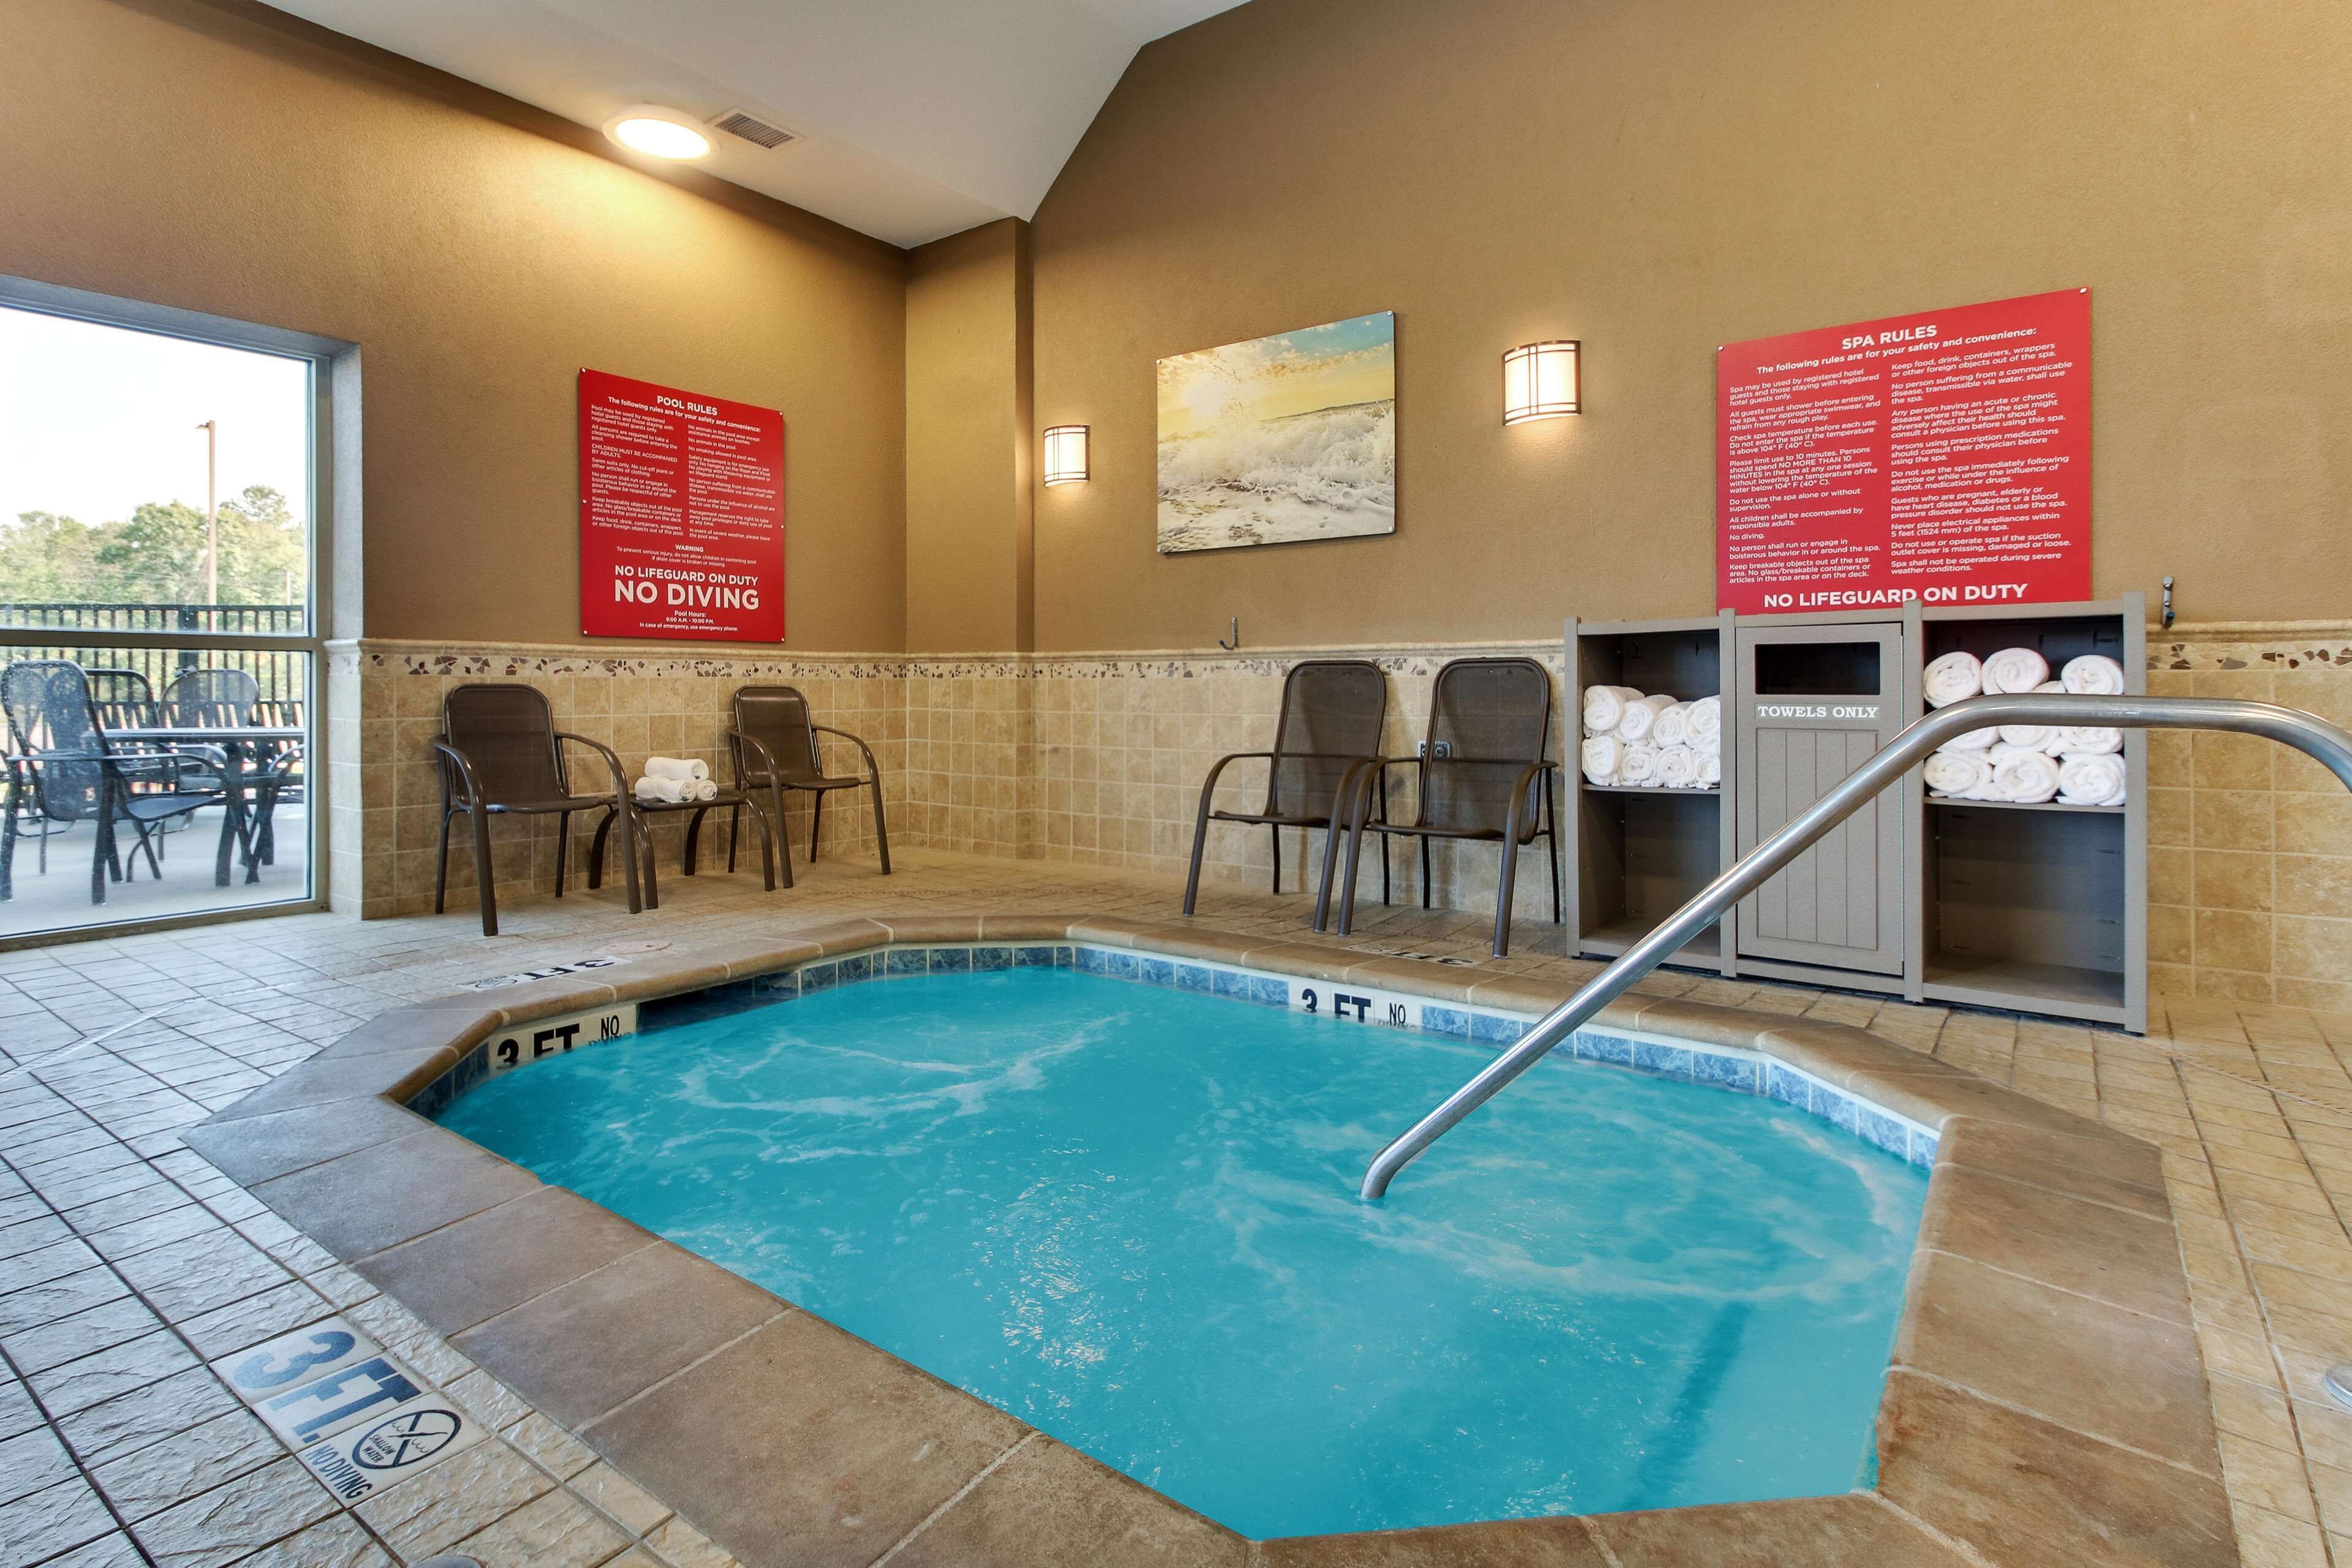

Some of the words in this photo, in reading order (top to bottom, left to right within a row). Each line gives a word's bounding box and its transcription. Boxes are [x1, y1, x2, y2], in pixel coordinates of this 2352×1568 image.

[1842, 334, 1875, 349] SPA
[1880, 325, 1937, 344] RULES
[1775, 360, 1819, 371] following
[1821, 356, 1845, 364] rules
[1882, 347, 1905, 357] your
[1908, 342, 1940, 352] safety
[1942, 337, 1962, 347] and
[1965, 328, 2036, 344] convenience:
[1804, 372, 1842, 382] registered
[621, 399, 648, 410] following
[657, 395, 684, 409] POOL
[687, 402, 717, 415] RULES
[1891, 421, 1929, 431] adversely
[2007, 409, 2036, 418] should
[1950, 434, 2002, 445] prescription
[2004, 428, 2059, 439] medications
[1975, 440, 2016, 450] physician
[1793, 458, 1815, 467] MORE
[1924, 480, 1972, 489] medication
[1800, 508, 1851, 517] accompanied
[1982, 515, 2029, 524] appliances
[615, 565, 633, 576] NO
[638, 567, 705, 581] LIFEGUARD
[708, 573, 725, 583] ON
[729, 575, 758, 586] DUTY
[615, 579, 657, 603] NO
[667, 583, 758, 609] DIVING
[1764, 594, 1793, 607] NO
[1799, 589, 1917, 606] LIFEGUARD
[1923, 586, 1957, 601] ON
[1965, 583, 2027, 600] DUTY
[1757, 706, 1827, 718] TOWELS
[1832, 706, 1879, 718] ONLY
[1390, 1003, 1406, 1024] NO
[601, 1015, 619, 1037] NO
[233, 1331, 356, 1389] 3
[304, 1444, 339, 1465] NO
[363, 1446, 384, 1463] WATER
[369, 1434, 397, 1455] SHALLOW
[319, 1457, 373, 1499] DIVING
